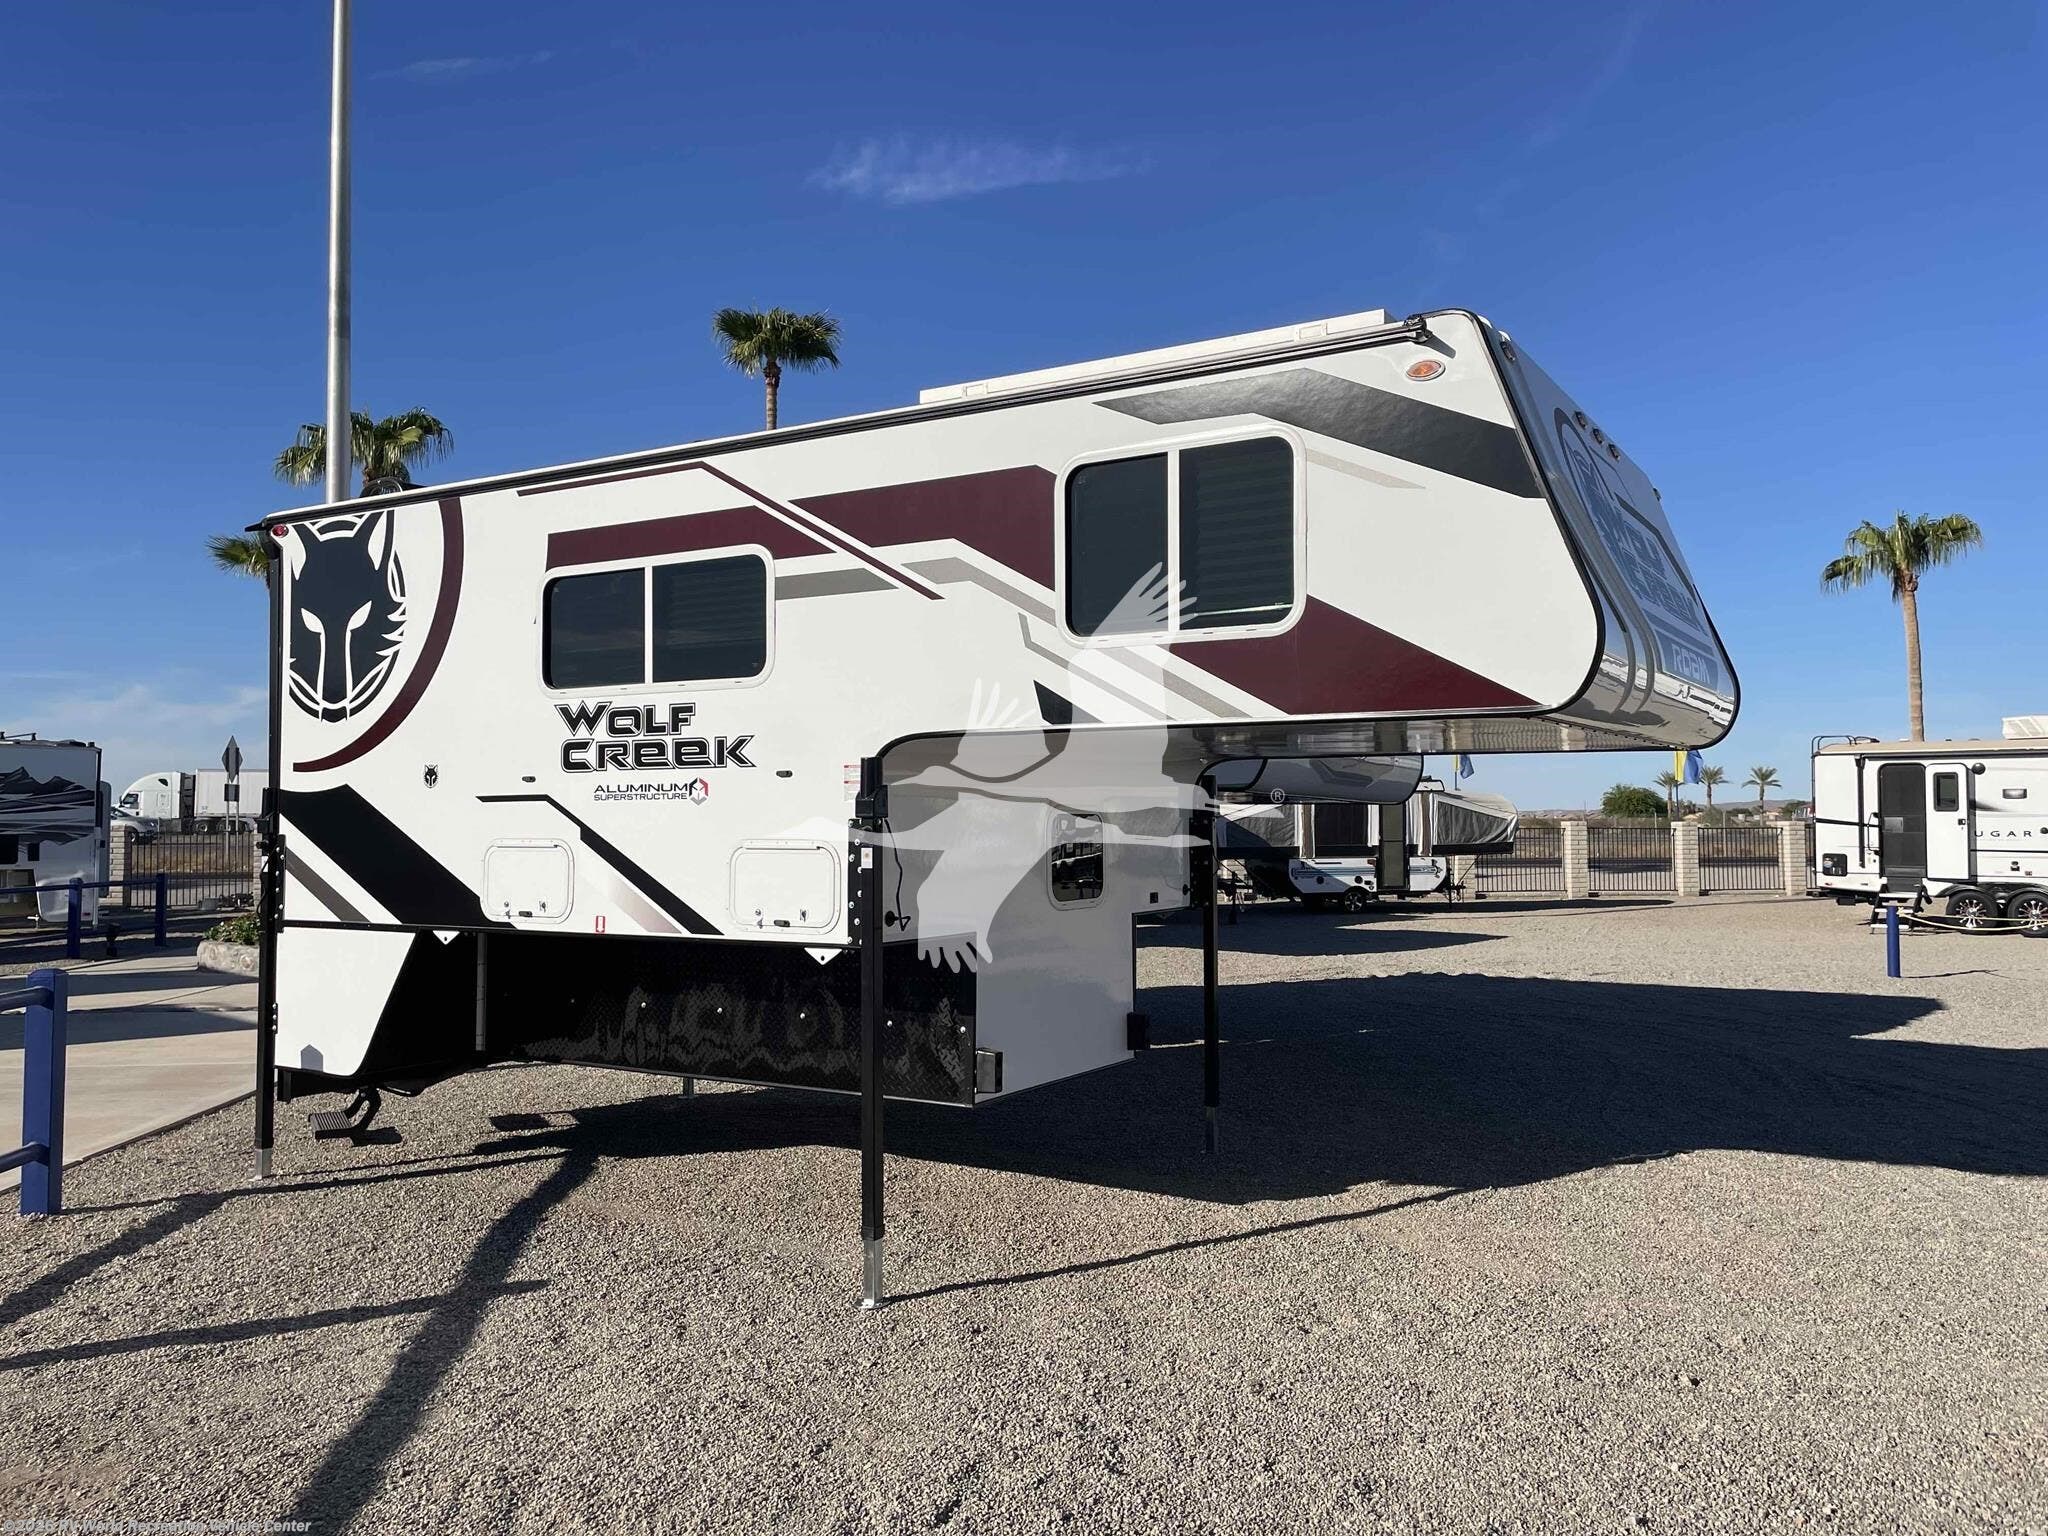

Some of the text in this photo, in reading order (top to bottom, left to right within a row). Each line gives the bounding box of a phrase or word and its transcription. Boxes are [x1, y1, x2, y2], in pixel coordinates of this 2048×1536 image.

[554, 700, 696, 737] WOLF
[594, 783, 688, 793] ALUMINUM
[594, 792, 688, 801] SUPERSTRUCTURE
